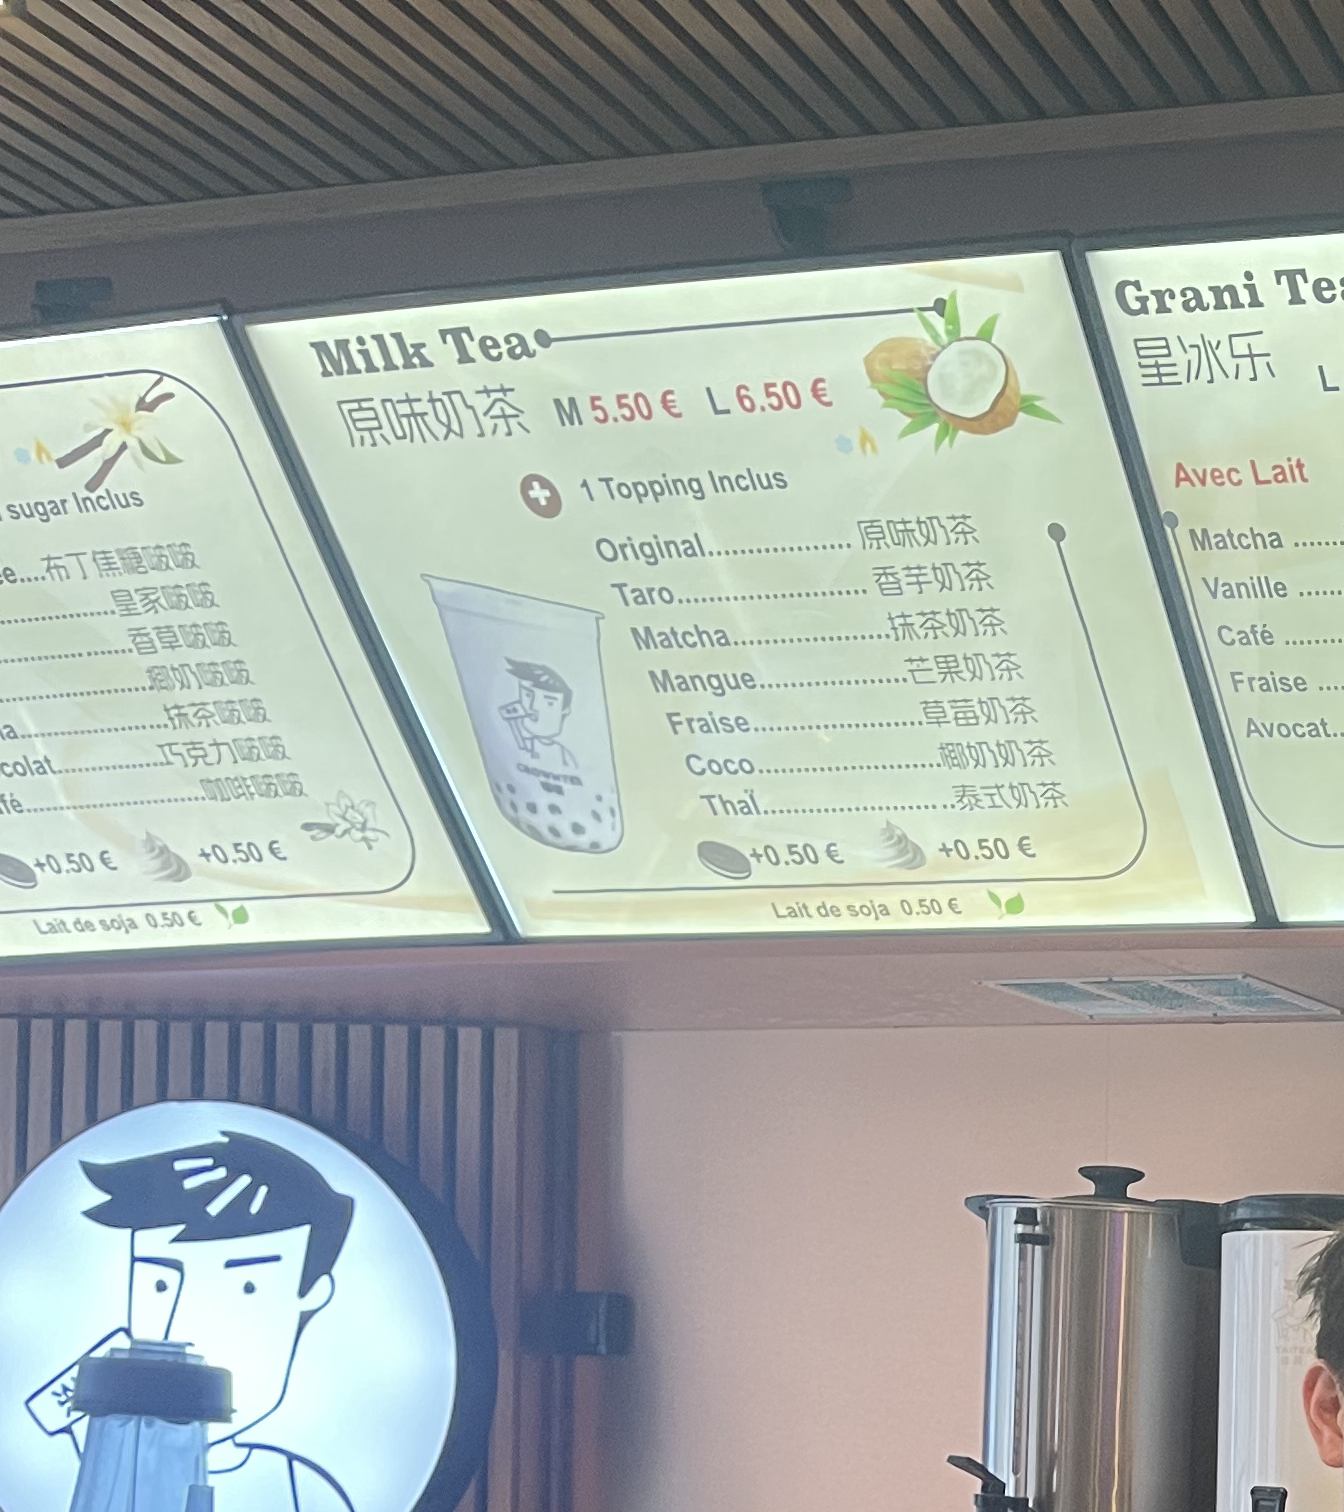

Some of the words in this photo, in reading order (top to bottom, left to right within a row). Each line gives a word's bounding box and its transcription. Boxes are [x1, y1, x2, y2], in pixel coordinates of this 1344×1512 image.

[1115, 270, 1265, 317] Grani
[309, 331, 434, 378] Milk
[438, 326, 537, 365] Tea
[1133, 330, 1276, 387] 星冰乐
[1318, 364, 1340, 392] L
[337, 383, 530, 448] 原味奶茶
[554, 396, 583, 427] M
[590, 392, 654, 425] 5.50
[660, 389, 683, 419] €
[706, 386, 731, 416] L
[735, 380, 800, 414] 6.50
[810, 377, 833, 408] €
[598, 473, 706, 505] Topping
[707, 467, 788, 495] Inclus
[1174, 461, 1243, 488] Avec
[1250, 457, 1309, 486] Lait
[6, 498, 69, 523] sugar
[72, 488, 145, 514] Inclus
[857, 513, 980, 551] 原味奶茶
[1189, 527, 1284, 552] Matcha
[596, 534, 706, 566] Original
[871, 560, 995, 597] 香芋奶茶
[1201, 576, 1288, 600] Vanille
[611, 582, 675, 608] Taro
[629, 625, 731, 652] Matcha
[887, 606, 1008, 642] 抹茶奶茶
[1216, 623, 1275, 647] Café
[649, 668, 757, 697] Mangue
[903, 651, 1024, 686] 芒果奶茶
[1229, 670, 1308, 694] Fraise
[666, 710, 751, 736] Fraise
[920, 695, 1039, 728] 草莓奶茶
[1245, 717, 1332, 739] Avocat
[685, 754, 755, 777] Coco
[938, 739, 1057, 771] 椰奶奶茶
[700, 788, 761, 818] Thaï
[952, 781, 1069, 812] 泰式奶茶
[750, 843, 819, 867] +0.50
[938, 837, 1010, 861] +0.50
[99, 913, 139, 934] soja
[145, 911, 184, 929] 0.50
[771, 901, 813, 920] Lait
[816, 902, 842, 918] de
[847, 901, 890, 921] soja
[899, 898, 943, 916] 0.50
